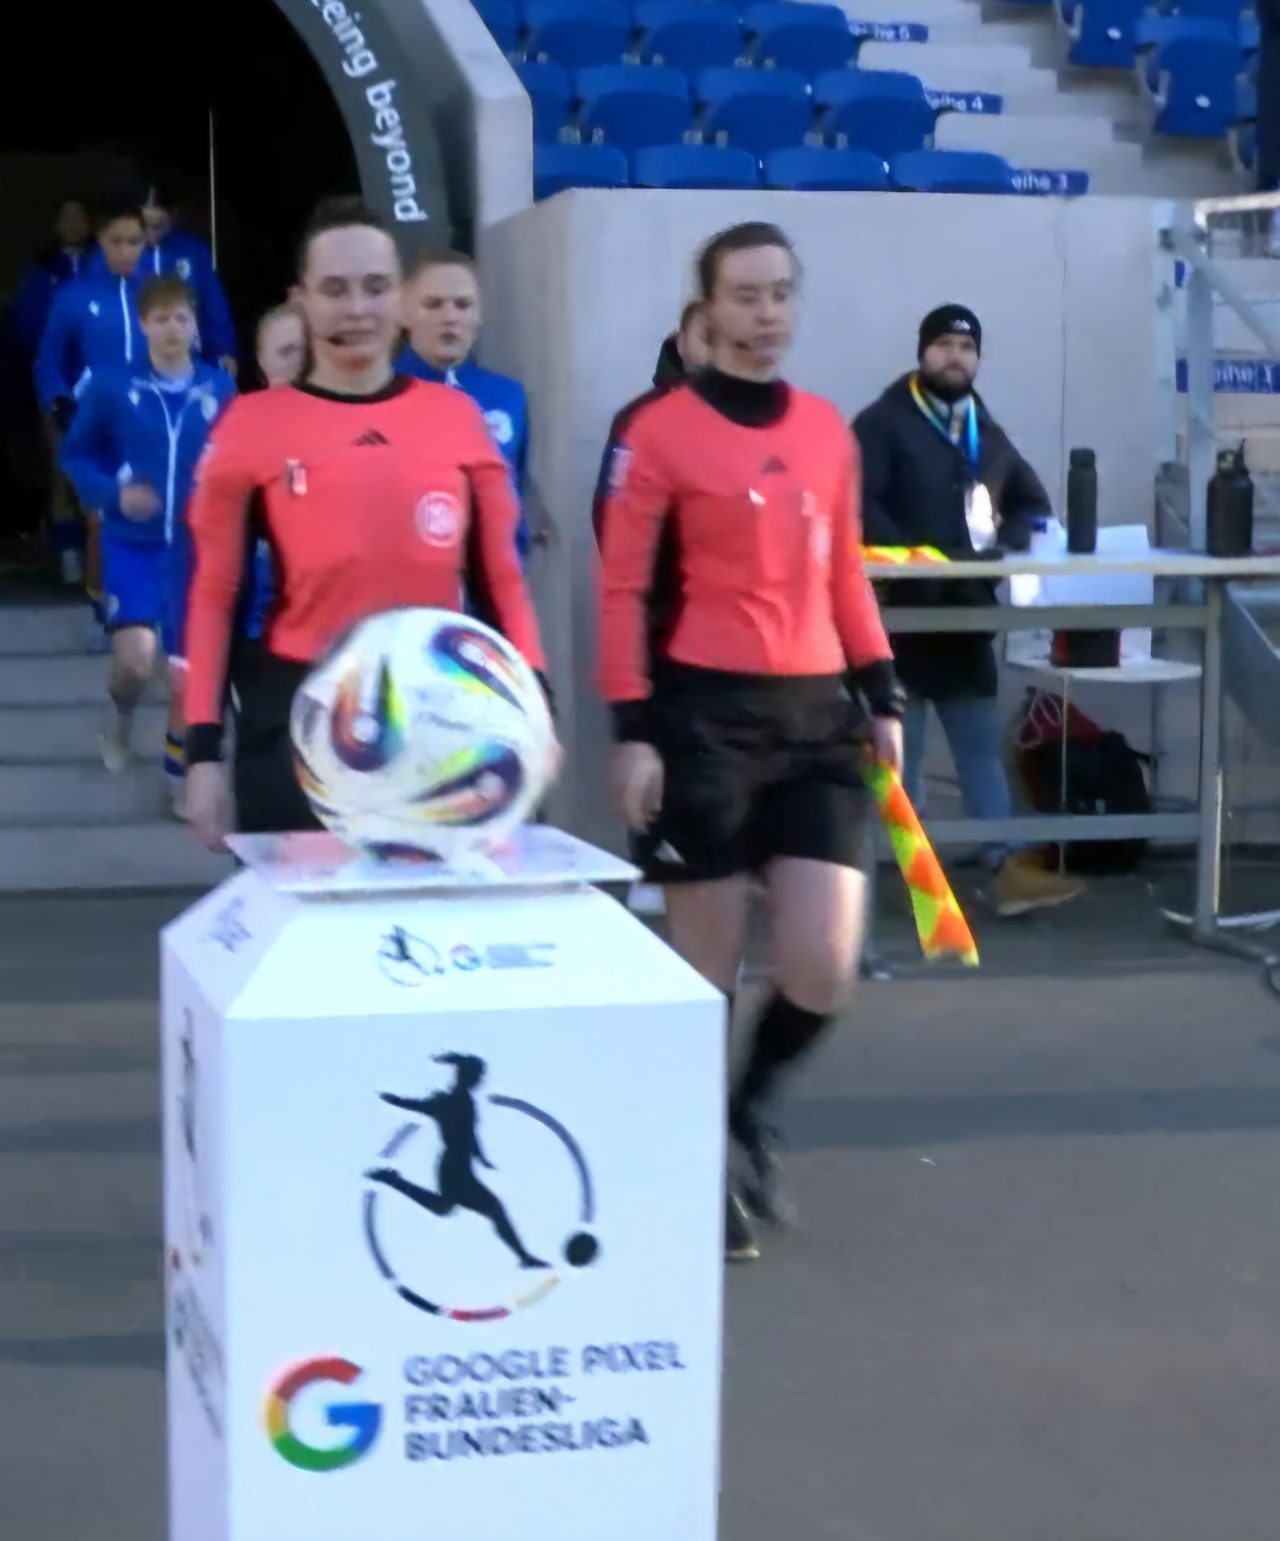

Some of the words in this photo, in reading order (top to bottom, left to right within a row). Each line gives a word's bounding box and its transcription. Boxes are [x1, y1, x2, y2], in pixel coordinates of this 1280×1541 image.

[311, 0, 377, 78] eing
[366, 79, 428, 222] beyond
[927, 94, 967, 112] eihe
[971, 95, 983, 111] 4
[1011, 173, 1051, 191] eihe
[403, 1346, 571, 1386] GOOGLE
[581, 1340, 688, 1375] PIXEL
[404, 1386, 577, 1424] FRAUEN-
[404, 1416, 651, 1462] BUNDESLIGA
